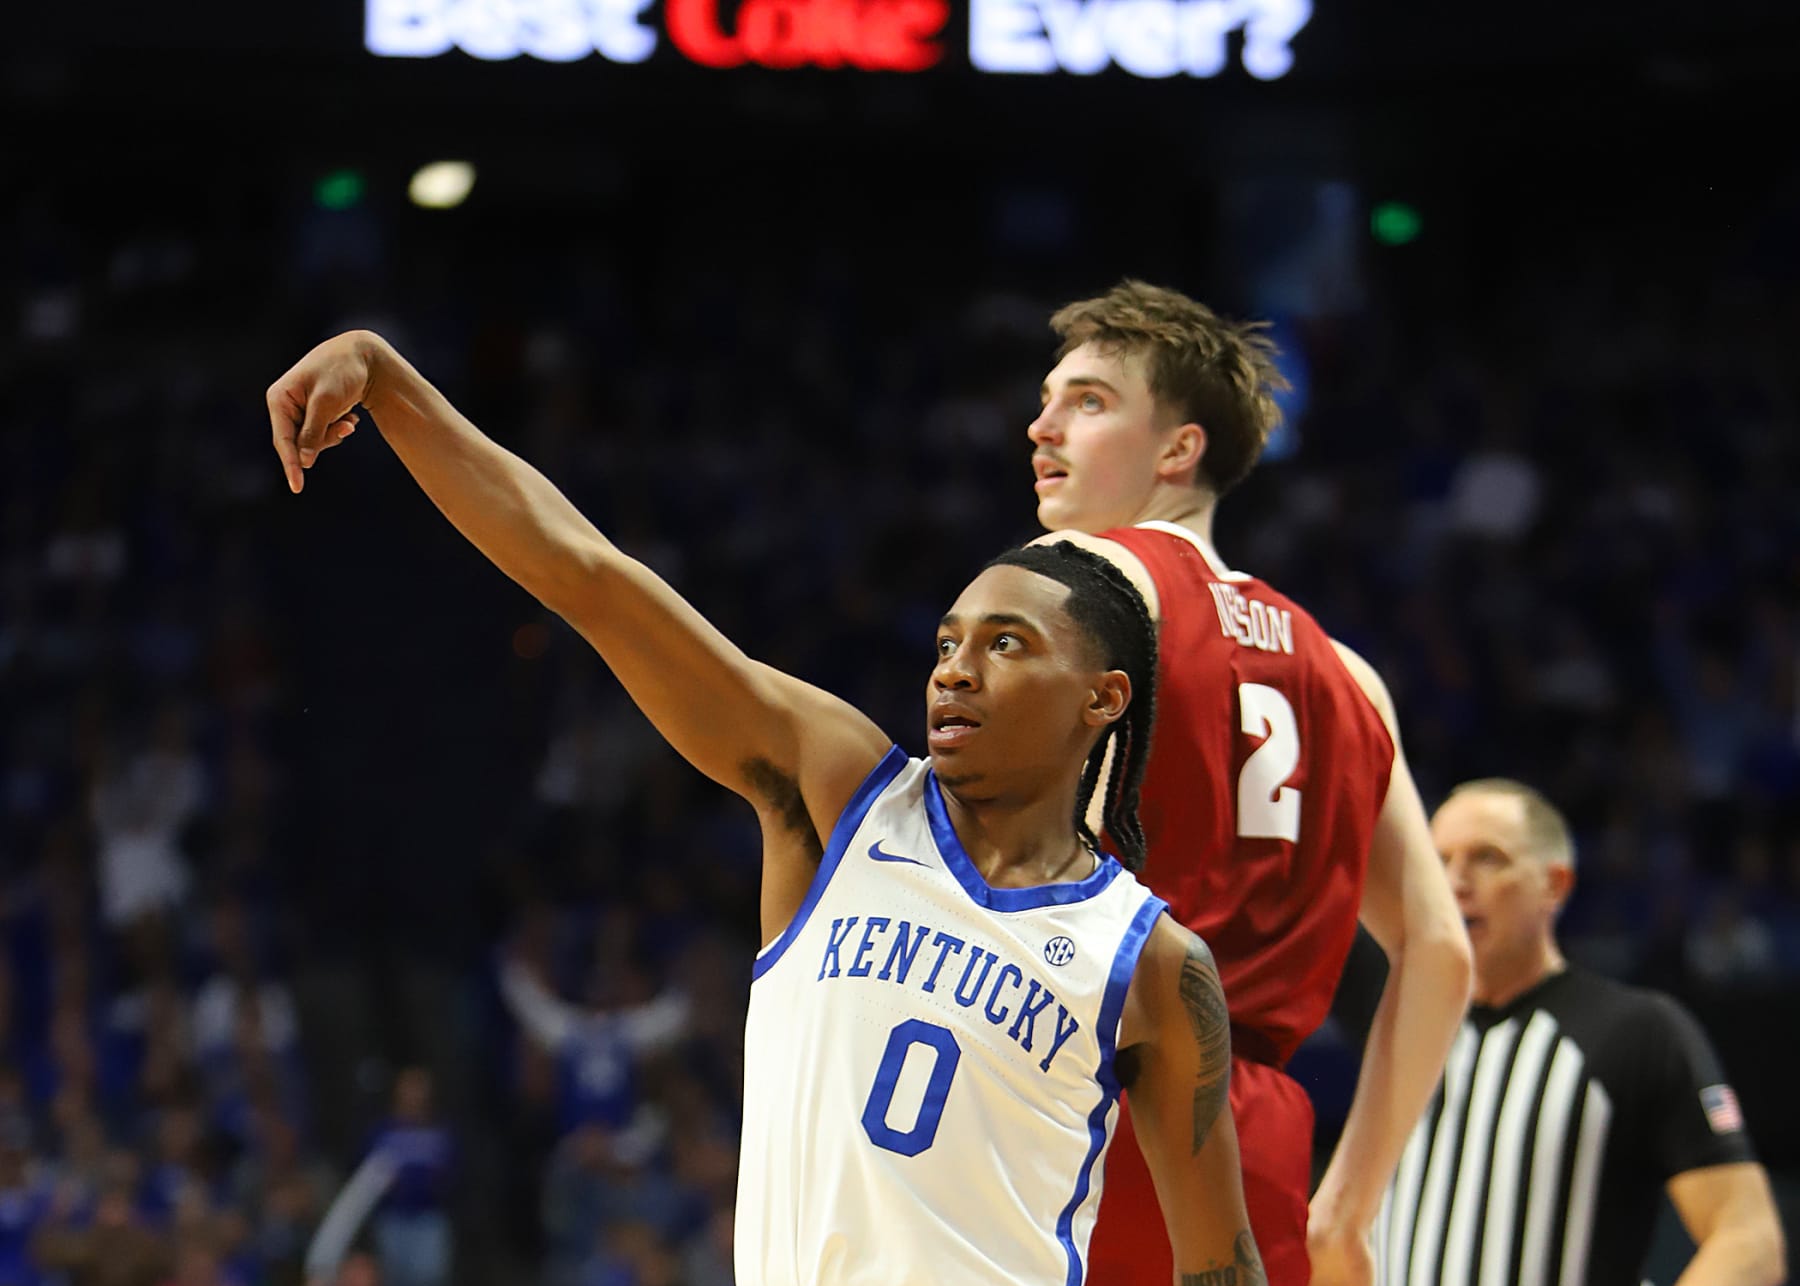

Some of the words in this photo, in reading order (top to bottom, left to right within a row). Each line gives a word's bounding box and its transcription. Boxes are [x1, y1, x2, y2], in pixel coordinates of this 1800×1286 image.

[1237, 682, 1302, 844] 2
[817, 915, 1079, 1073] KENTUCKY
[861, 1018, 961, 1158] 0
